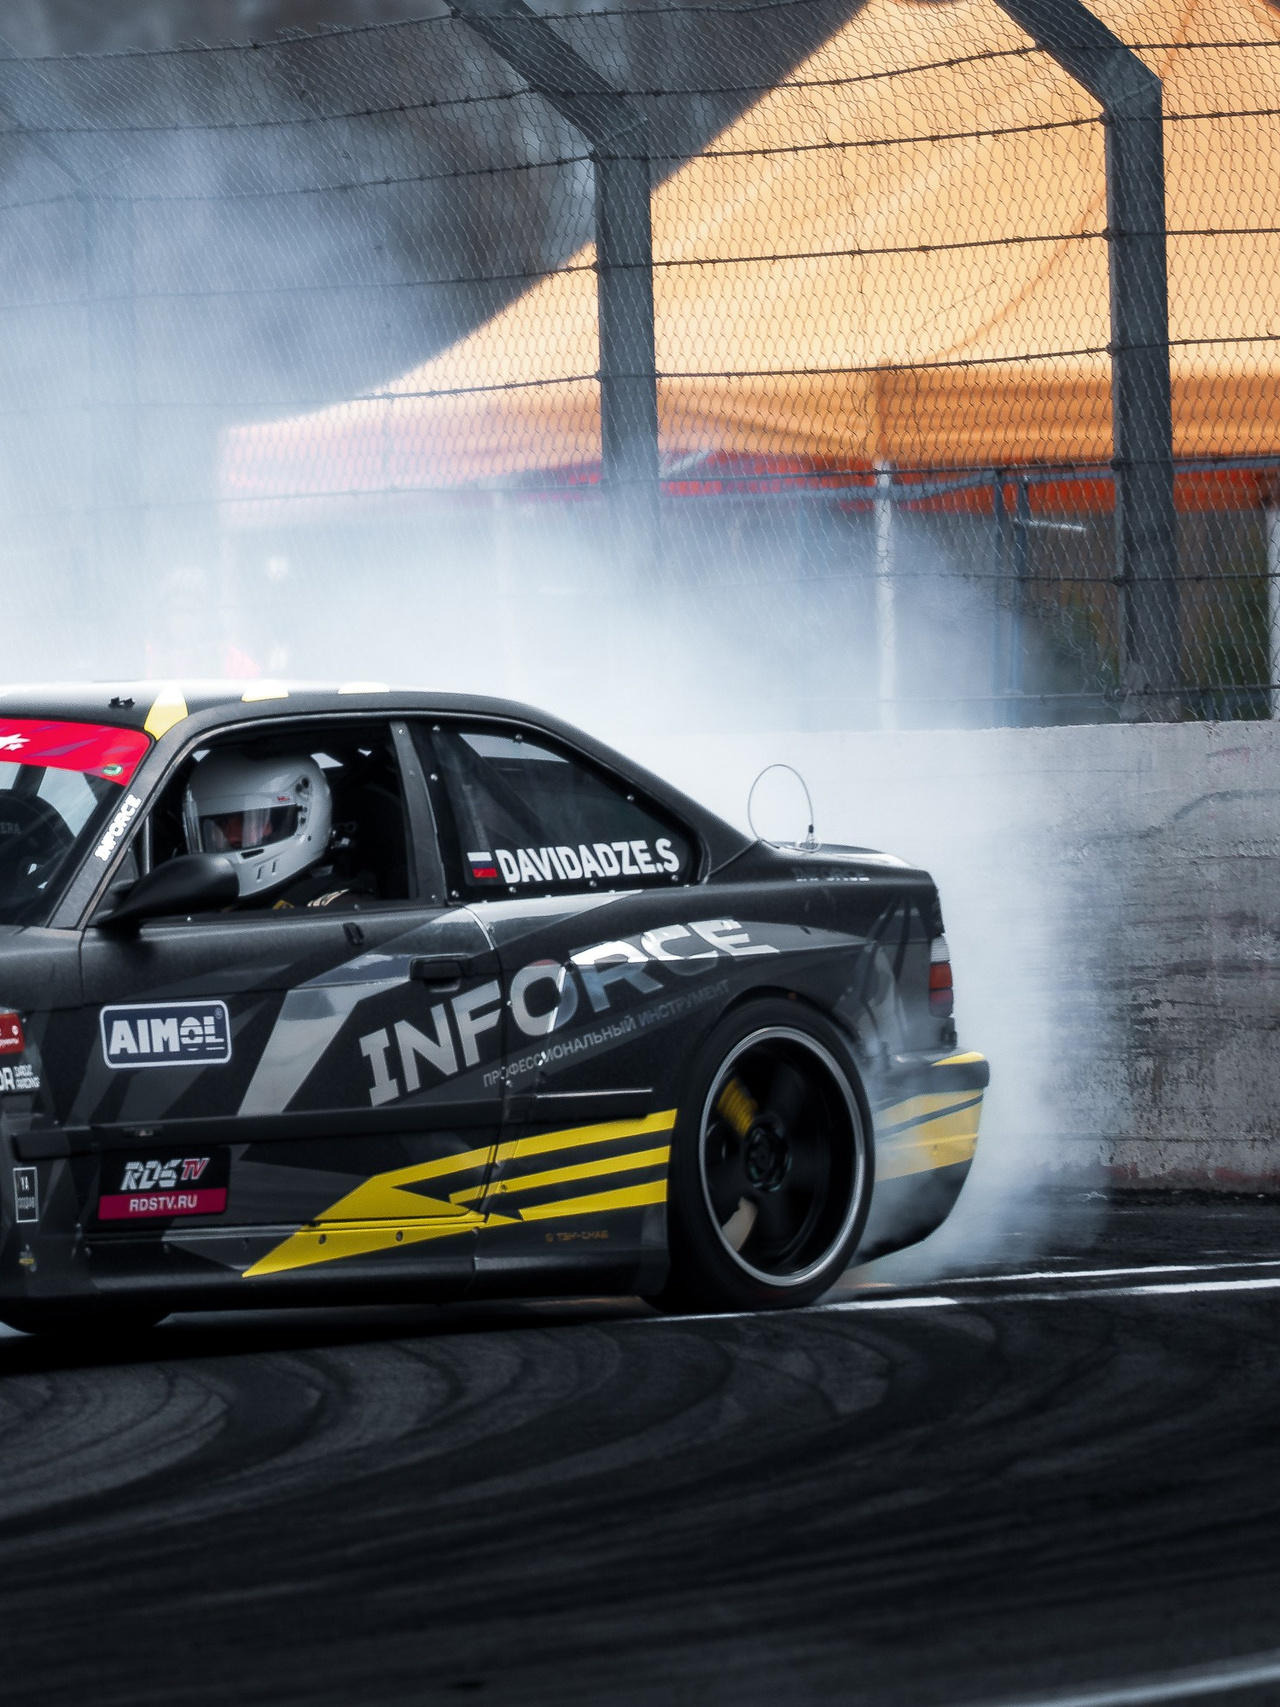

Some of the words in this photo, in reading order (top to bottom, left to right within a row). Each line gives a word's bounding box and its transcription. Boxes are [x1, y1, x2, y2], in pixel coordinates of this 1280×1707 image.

[495, 837, 680, 885] DAVIDADZE.S
[359, 918, 780, 1107] INFORCE
[638, 978, 730, 1027] ИНСТРУМЕНТ
[109, 1016, 225, 1055] AIMOL
[120, 1159, 182, 1191] RDS
[129, 1194, 198, 1212] RDSTV.RU
